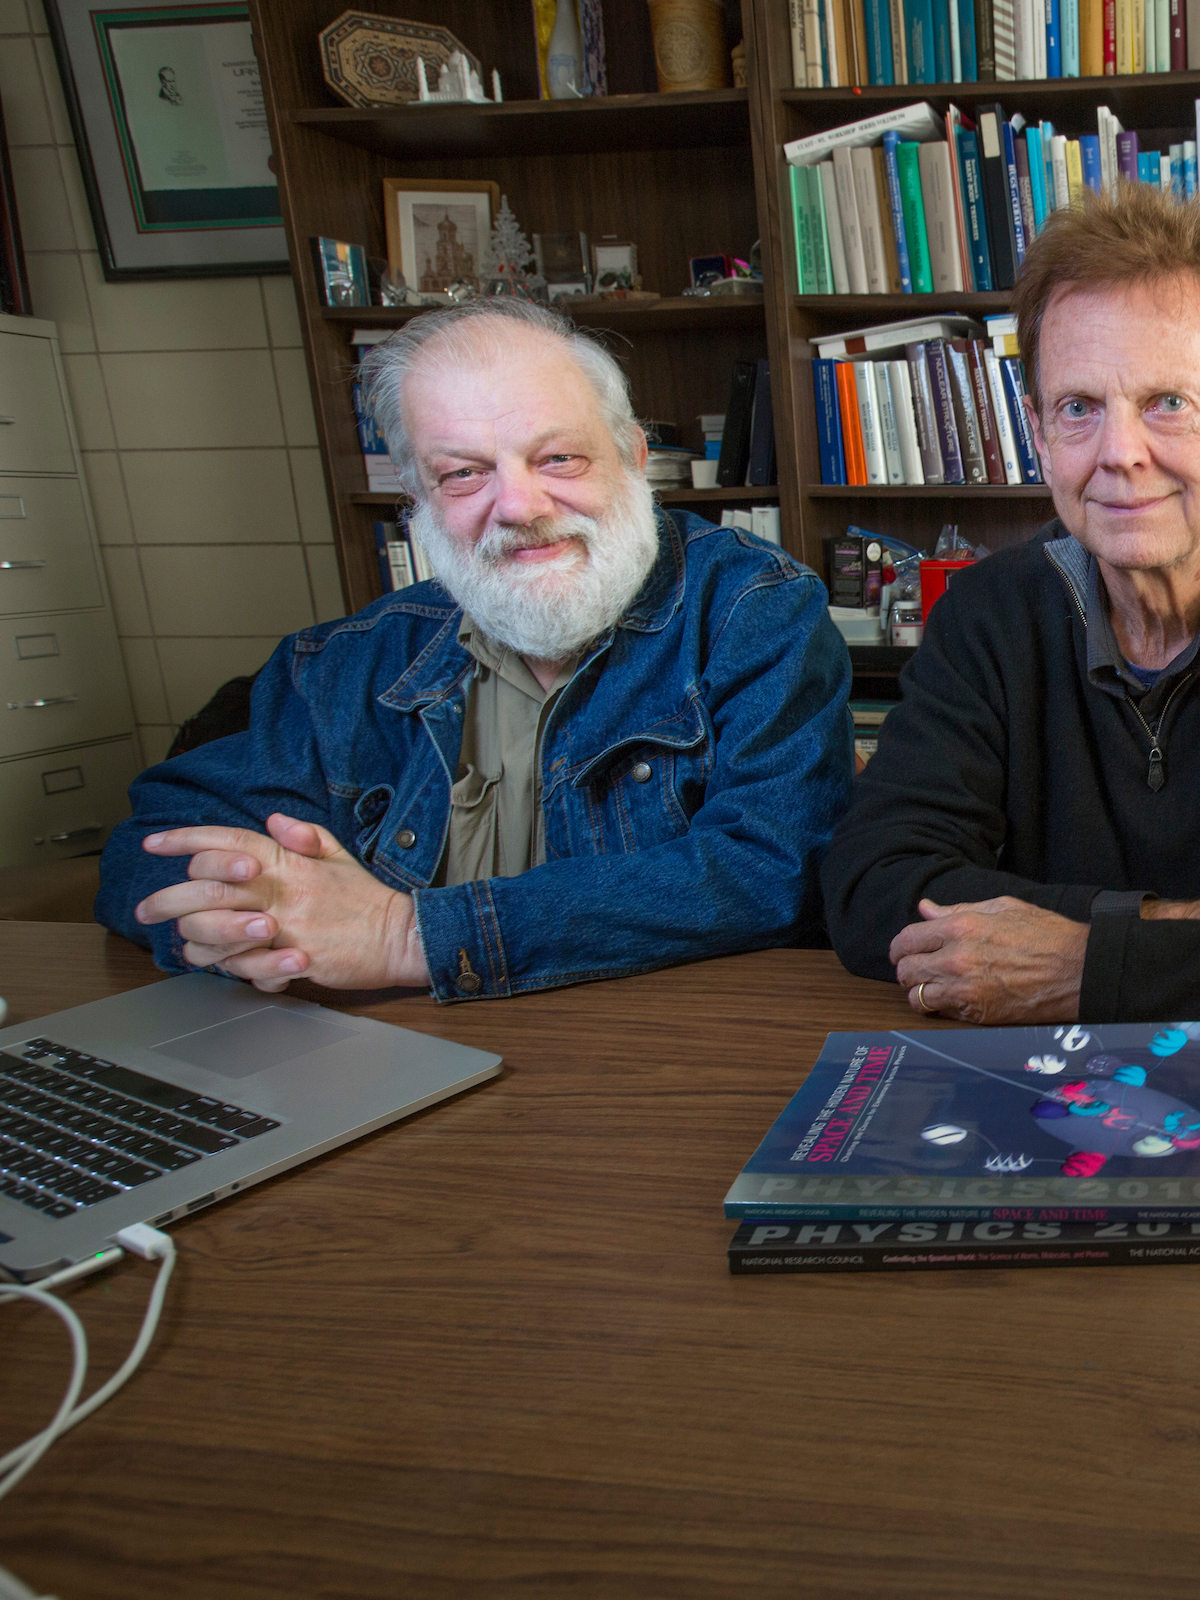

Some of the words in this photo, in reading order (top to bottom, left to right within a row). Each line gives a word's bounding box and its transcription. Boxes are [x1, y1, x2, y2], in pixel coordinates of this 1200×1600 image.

[1008, 164, 1017, 189] HUGS
[970, 205, 979, 241] THEORIES
[1012, 197, 1021, 226] CEBAF
[1016, 233, 1024, 252] 1992
[935, 358, 947, 399] NUCLEAR
[942, 401, 955, 453] STRUCTURE
[963, 401, 976, 454] STRUCTURE
[981, 408, 990, 441] THEORIES
[998, 415, 1006, 438] Physics
[854, 1045, 870, 1055] OF
[892, 1045, 908, 1065] Physics
[840, 1056, 865, 1083] NATURE
[854, 1045, 892, 1083] TIME
[824, 1084, 850, 1107] HIDDEN
[836, 1085, 873, 1114] AND
[817, 1108, 835, 1121] THE
[791, 1122, 826, 1160] REVEALING
[806, 1117, 854, 1162] SPACE
[757, 1177, 1059, 1200] PHYSICS
[859, 1209, 900, 1217] REVEALING
[903, 1209, 916, 1217] THE
[919, 1209, 947, 1217] HIDDEN
[949, 1209, 981, 1218] NATURE
[982, 1210, 991, 1218] OF
[992, 1208, 1035, 1220] SPACE
[1038, 1208, 1070, 1220] AND
[1072, 1208, 1108, 1220] TIME
[748, 1222, 1062, 1245] PHYSICS
[741, 1258, 782, 1266] NATIONAL
[784, 1257, 826, 1265] RESEARCH
[826, 1256, 865, 1265] COUNCIL
[928, 1254, 956, 1263] Quantum
[1129, 1248, 1146, 1258] THE
[1146, 1248, 1188, 1257] NATIONAL
